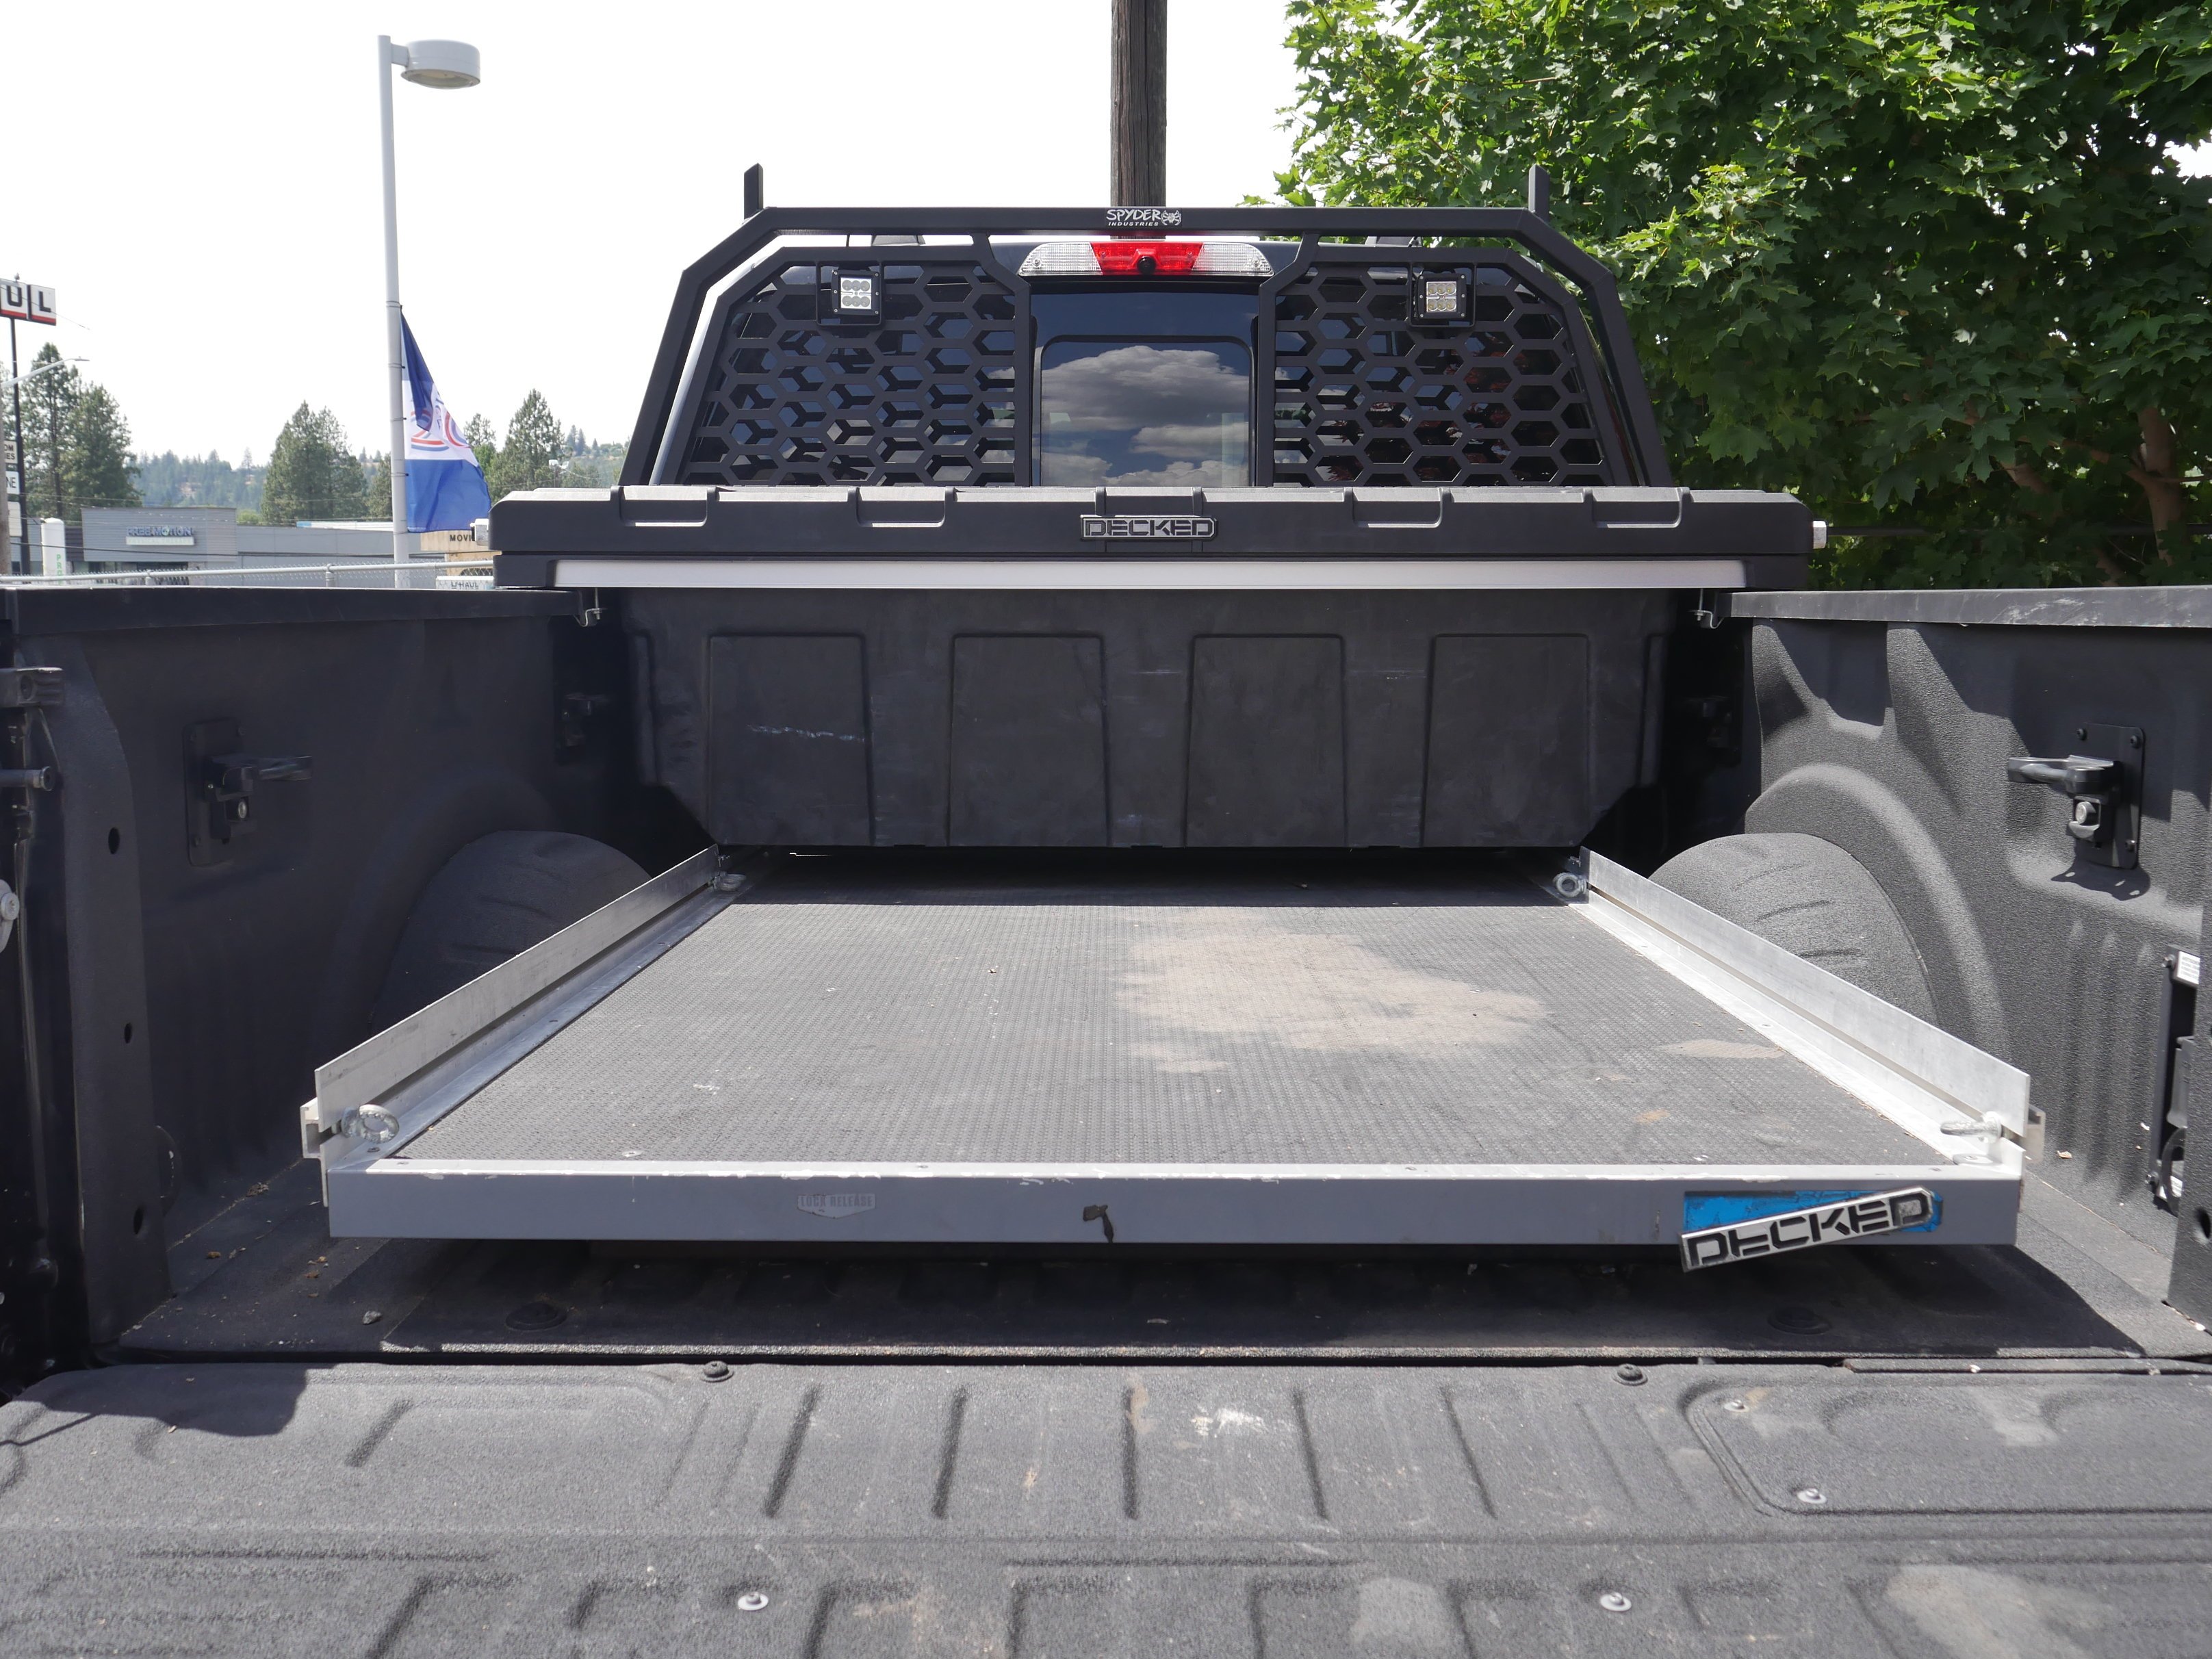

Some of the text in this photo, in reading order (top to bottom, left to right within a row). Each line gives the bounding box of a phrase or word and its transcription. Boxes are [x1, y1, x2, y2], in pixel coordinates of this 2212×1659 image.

[1106, 209, 1161, 221] SPYDER
[1085, 519, 1213, 536] DECKED
[801, 1196, 873, 1207] LOCK RELEASE
[1686, 1193, 1933, 1267] DECKED
